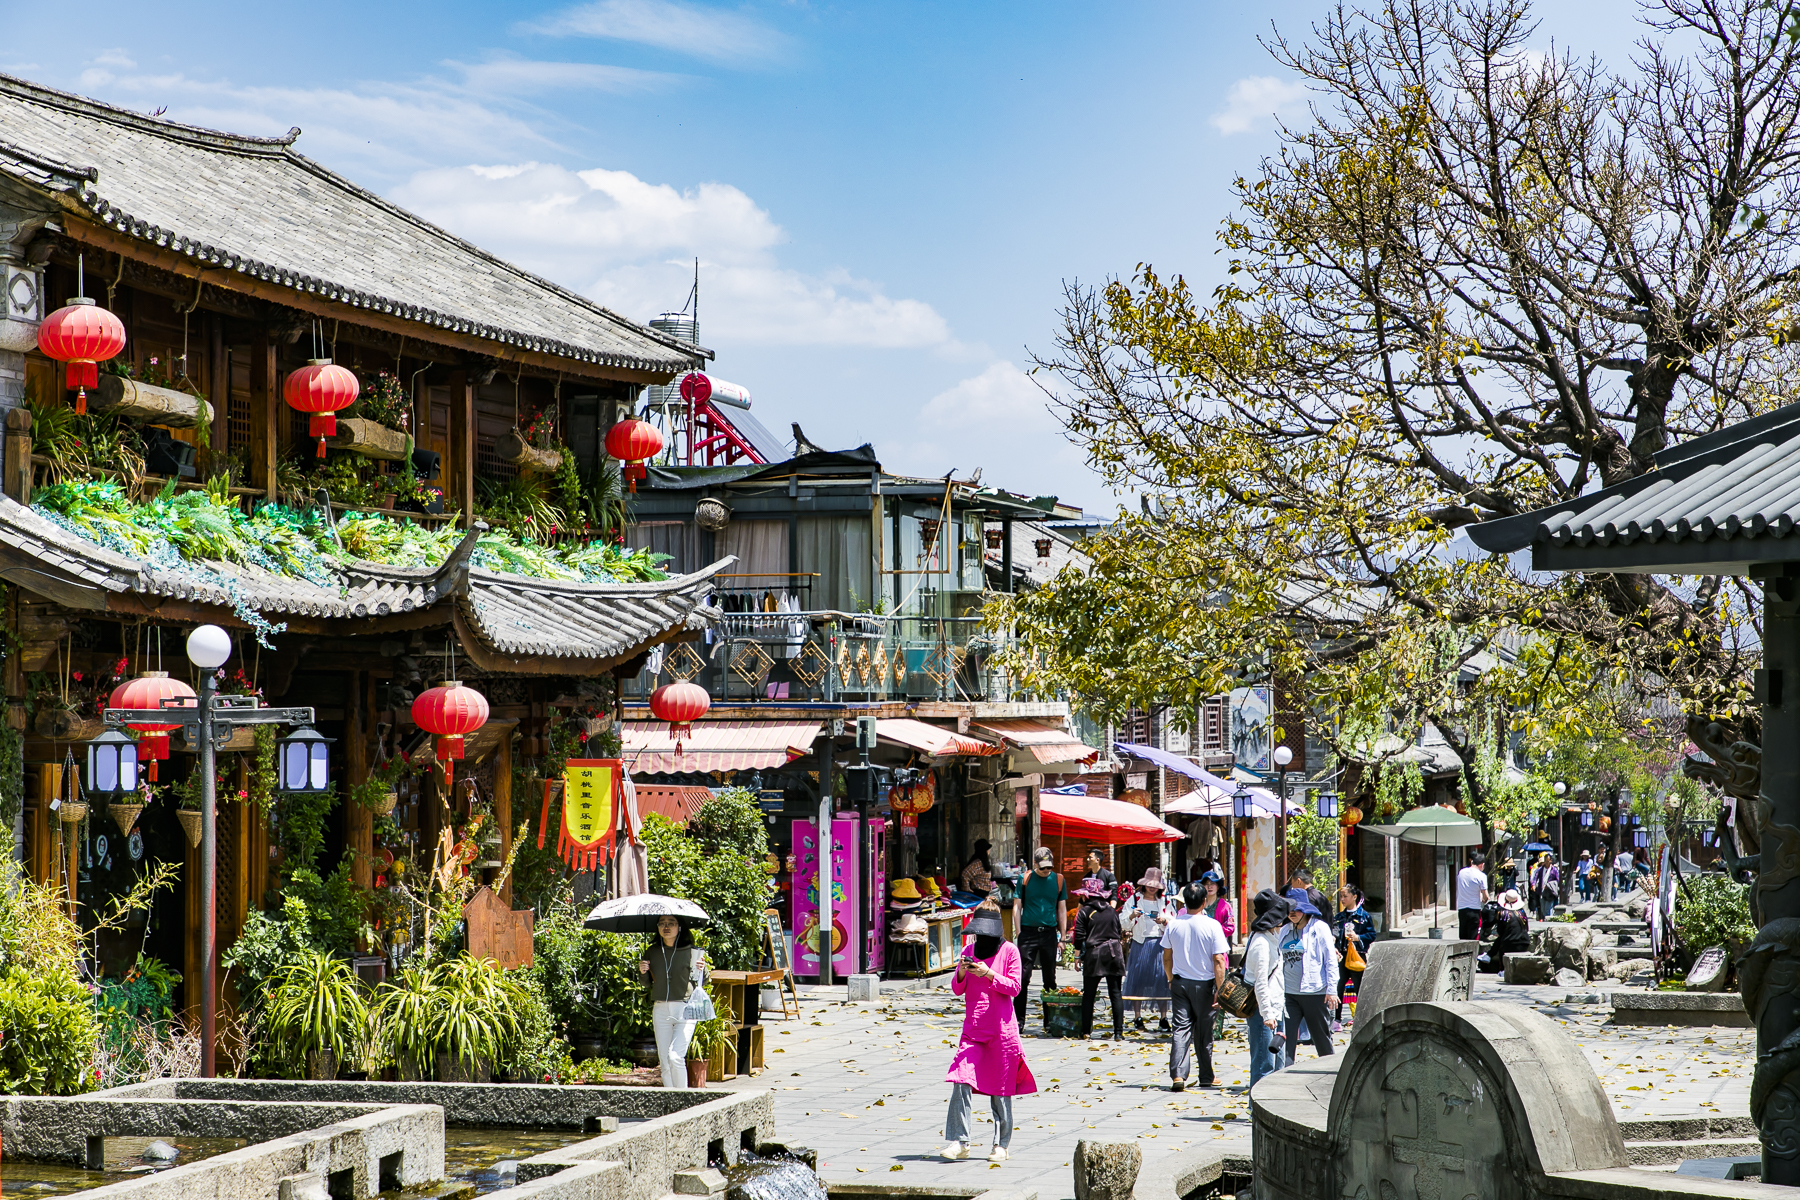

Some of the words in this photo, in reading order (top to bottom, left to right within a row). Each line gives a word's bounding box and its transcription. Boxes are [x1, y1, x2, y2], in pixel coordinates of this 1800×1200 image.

[580, 770, 592, 841] 胡桃里音乐酒馆
